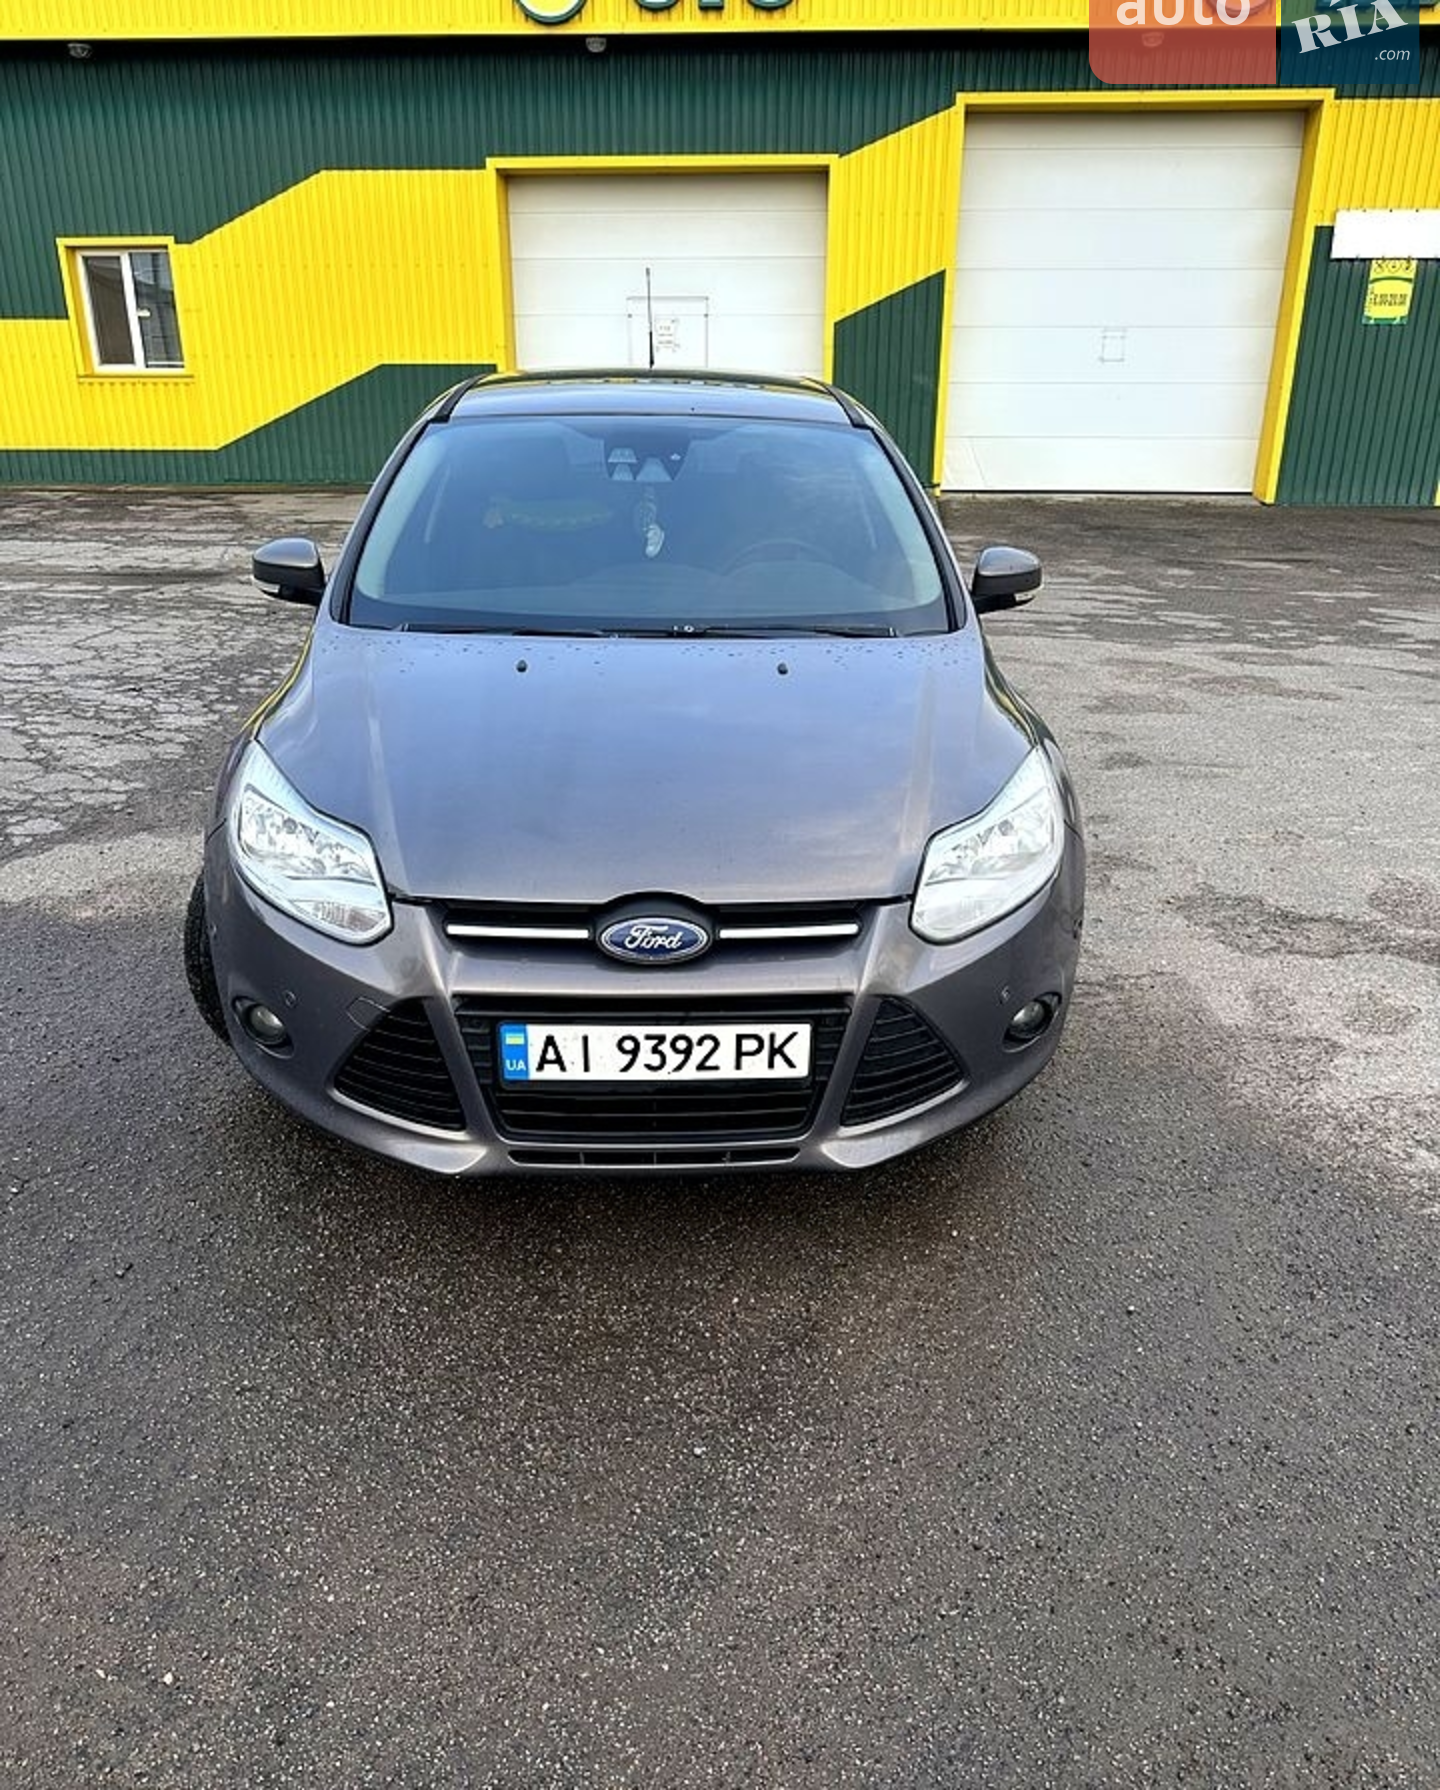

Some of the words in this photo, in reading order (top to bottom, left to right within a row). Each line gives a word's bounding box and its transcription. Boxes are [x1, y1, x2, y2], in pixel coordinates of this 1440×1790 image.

[624, 925, 683, 949] Ford
[616, 1033, 721, 1073] 9392
[734, 1031, 799, 1071] PK
[505, 1059, 527, 1072] UA
